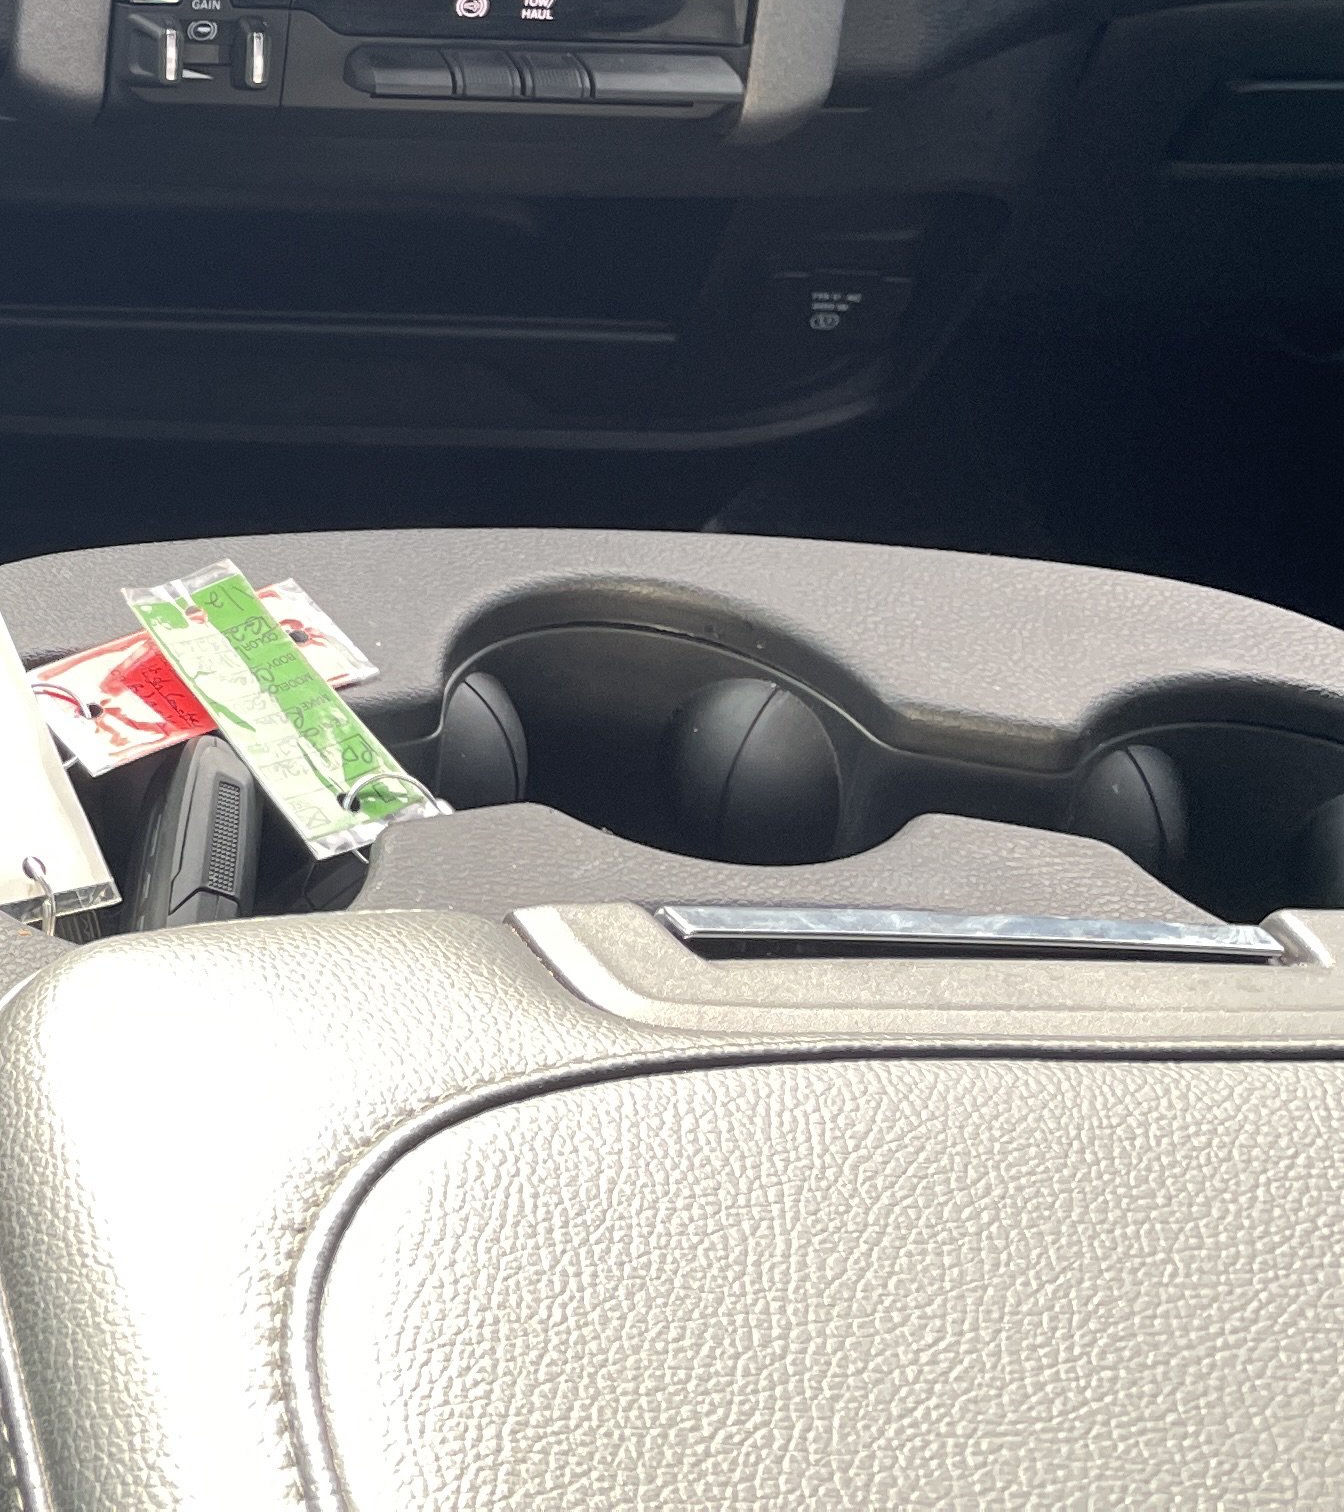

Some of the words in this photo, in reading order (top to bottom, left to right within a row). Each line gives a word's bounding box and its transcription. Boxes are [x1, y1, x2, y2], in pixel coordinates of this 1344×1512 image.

[191, 0, 221, 11] GAIN
[521, 8, 553, 21] HAUL
[244, 632, 279, 652] COLOR
[269, 652, 296, 671] BODY
